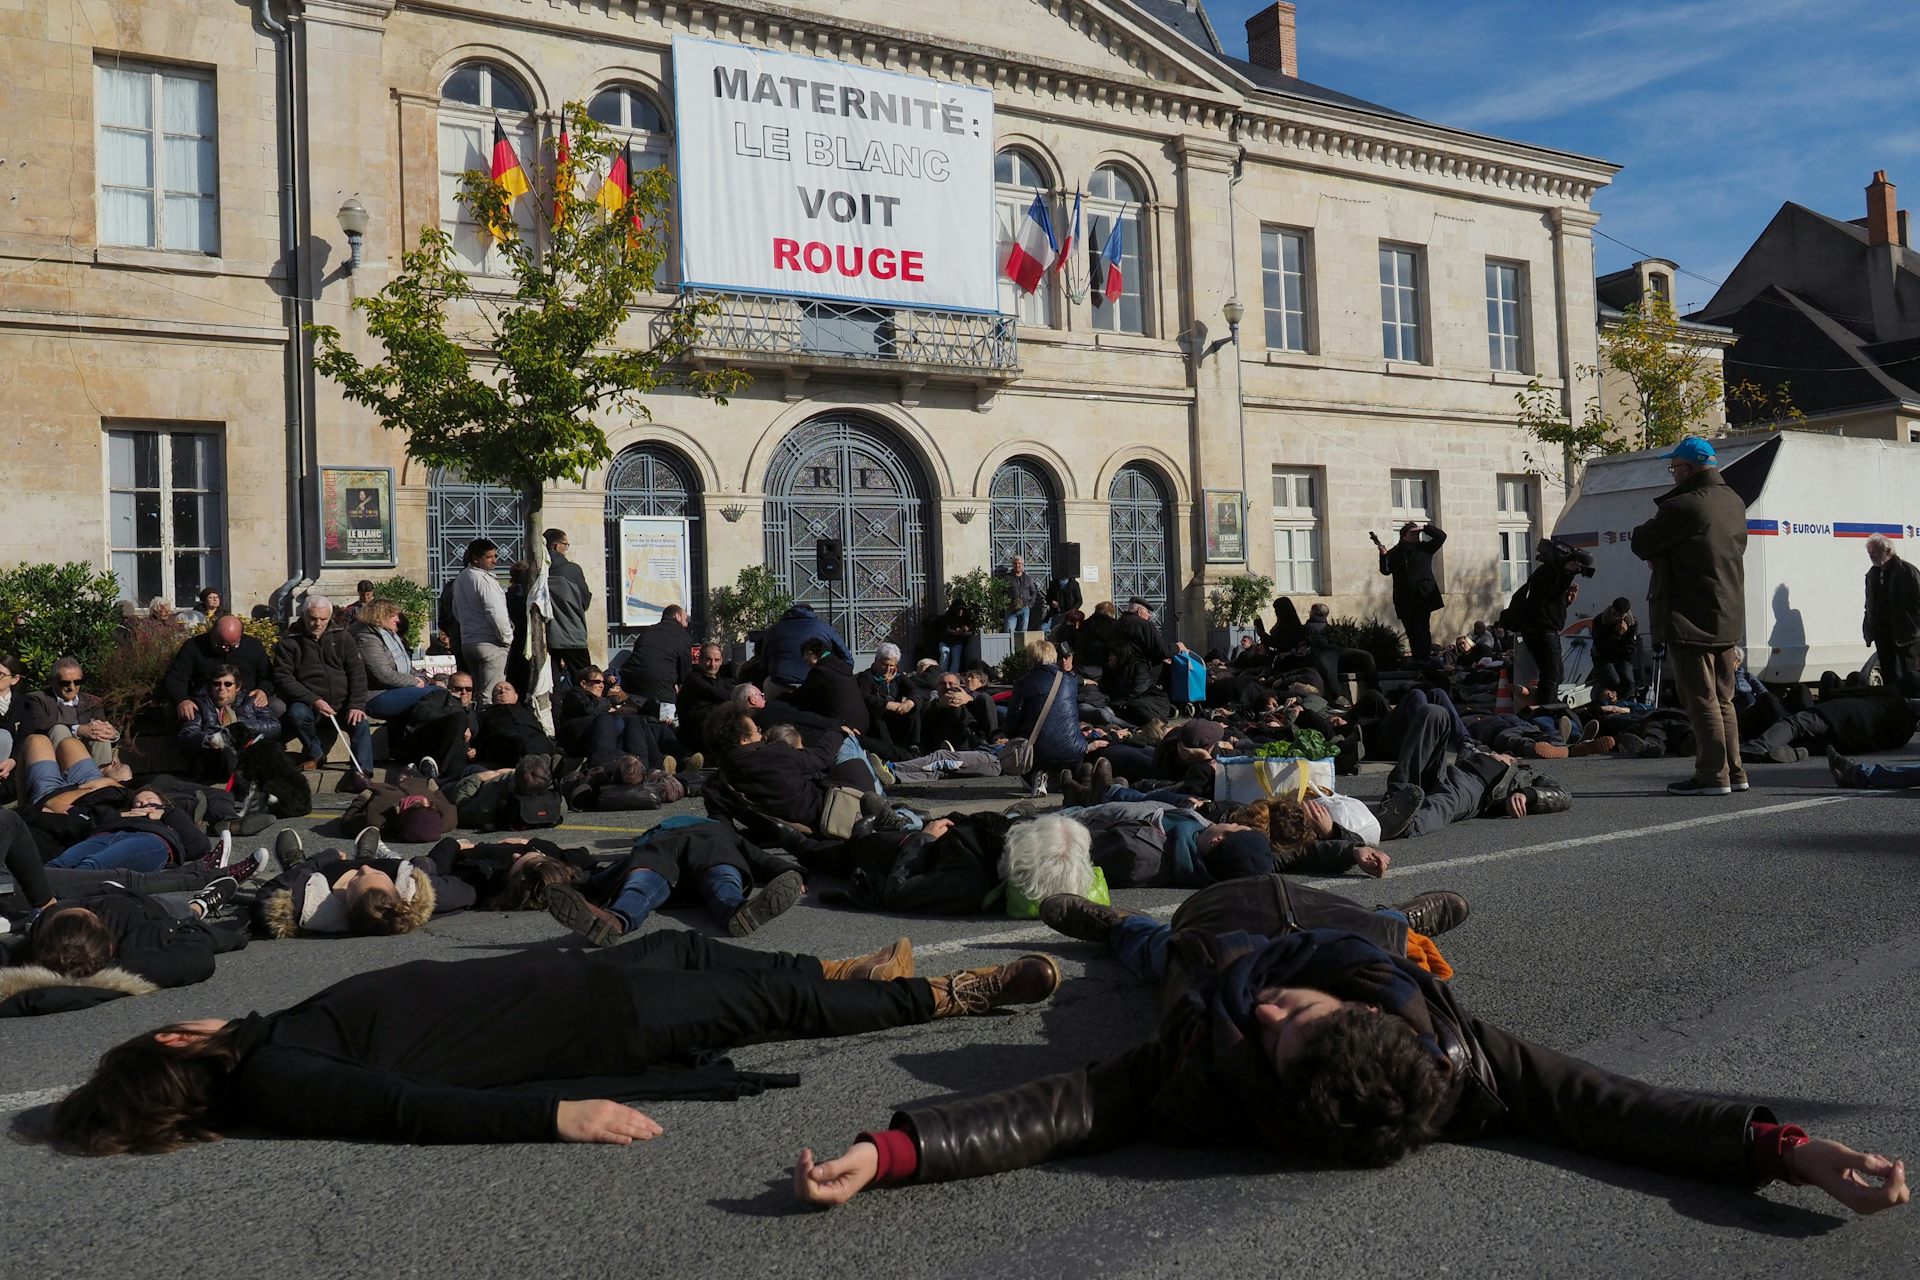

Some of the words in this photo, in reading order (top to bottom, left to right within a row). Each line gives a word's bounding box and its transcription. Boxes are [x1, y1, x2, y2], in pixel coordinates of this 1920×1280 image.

[734, 121, 791, 162] LE
[805, 131, 951, 183] BLANC
[796, 185, 901, 228] VOIT
[772, 237, 925, 283] ROUGE
[348, 530, 357, 539] LE
[357, 530, 382, 539] BLANC
[1793, 523, 1831, 535] EUROVIA
